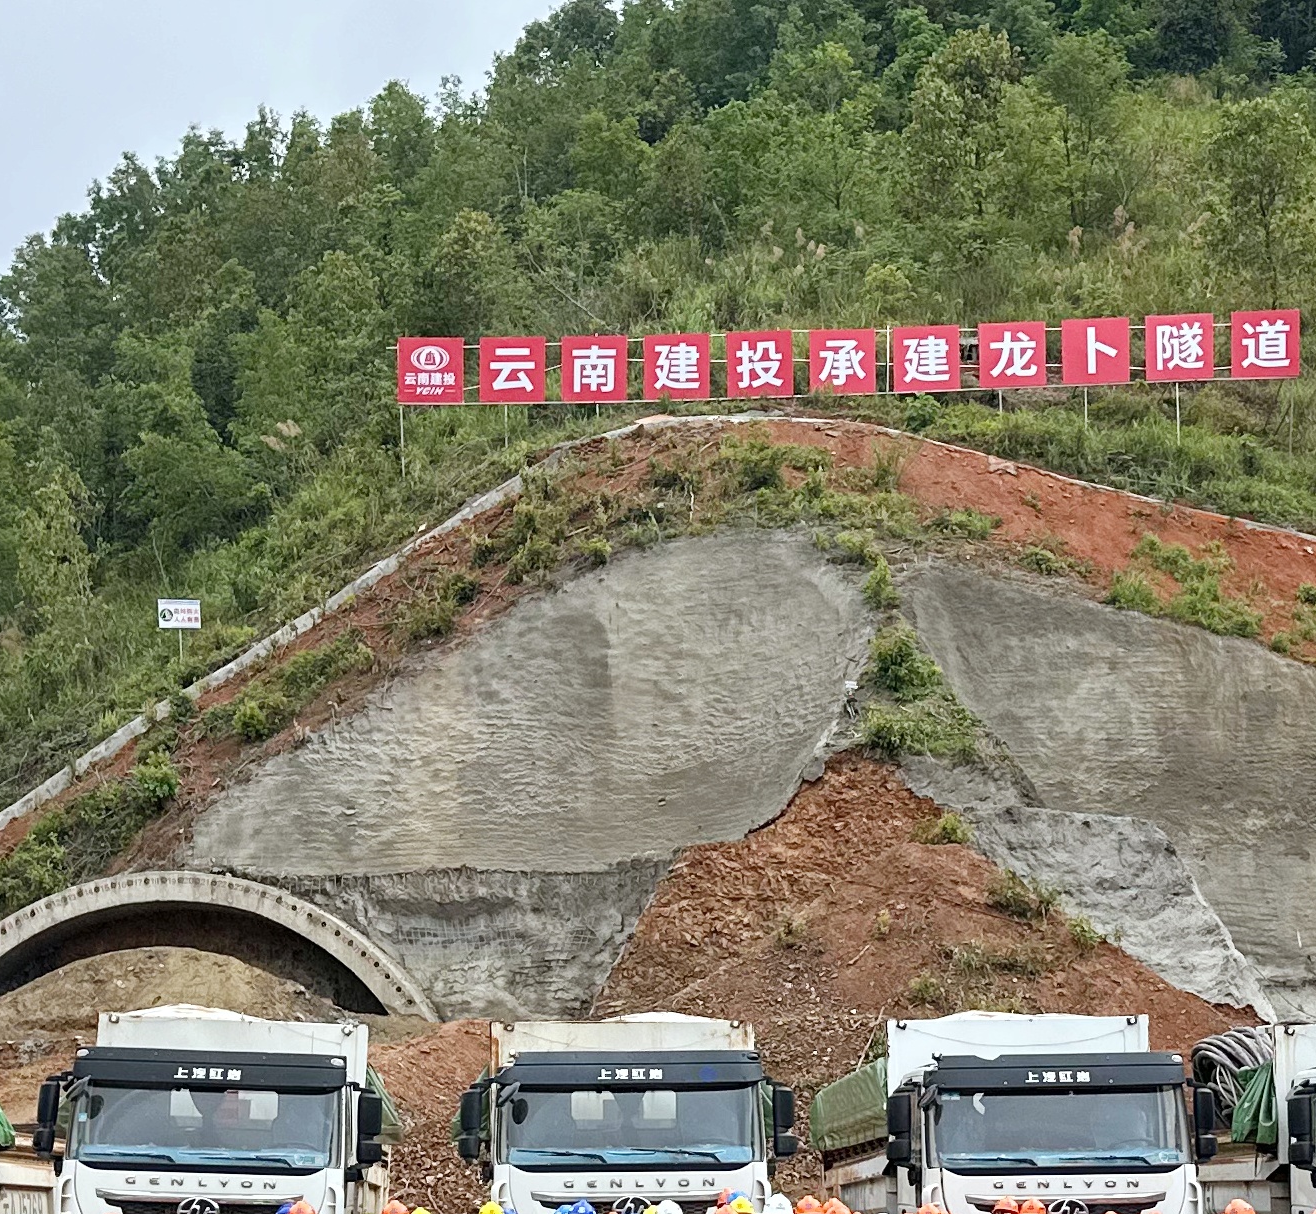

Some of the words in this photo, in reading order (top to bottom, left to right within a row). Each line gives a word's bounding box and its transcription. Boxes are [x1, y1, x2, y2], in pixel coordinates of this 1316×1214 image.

[490, 319, 1291, 393] 云南建投承建龙卜隧道
[404, 372, 455, 386] 云南建投
